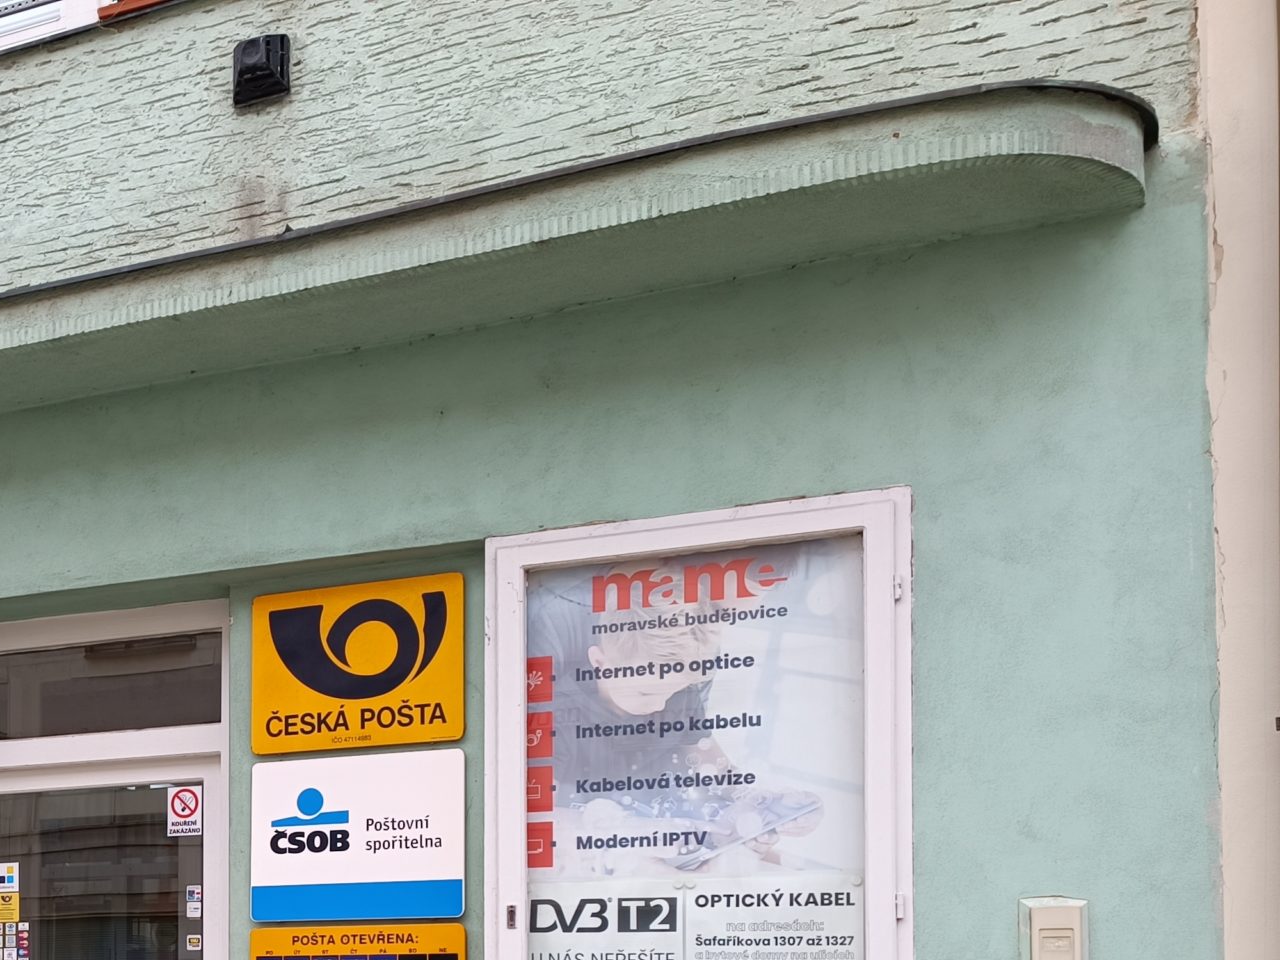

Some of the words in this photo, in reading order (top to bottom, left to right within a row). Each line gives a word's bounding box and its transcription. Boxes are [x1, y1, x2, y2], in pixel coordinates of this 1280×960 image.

[592, 558, 788, 613] mame
[591, 613, 679, 635] moravské
[684, 605, 788, 627] budějovice
[575, 660, 655, 682] Internet
[659, 662, 685, 680] po
[688, 653, 755, 678] optice
[265, 704, 350, 738] ČESKÁ
[359, 699, 447, 730] POŠTA
[576, 719, 655, 739] Internet
[659, 722, 685, 738] po
[689, 712, 762, 732] kabelu
[575, 773, 670, 794] Kabelová
[674, 769, 756, 789] televize
[169, 827, 201, 835] ZAKÁZÁNO
[171, 819, 197, 827] KOUŘENÍ
[366, 815, 430, 832] Poštovní
[270, 829, 350, 854] ČSOB
[365, 835, 443, 854] spořitelna
[576, 831, 658, 850] Moderní
[662, 831, 708, 847] IPTV
[694, 888, 784, 908] OPTICKÝ
[789, 892, 856, 907] KABEL
[621, 899, 671, 930] T2
[726, 921, 746, 932] na
[291, 932, 336, 946] POŠTA
[340, 931, 419, 945] OTEVŘENA:
[695, 934, 771, 946] Šafaříkova
[773, 936, 804, 946] 1307
[806, 935, 823, 946] až
[825, 936, 855, 946] 1327
[790, 952, 808, 960] na
